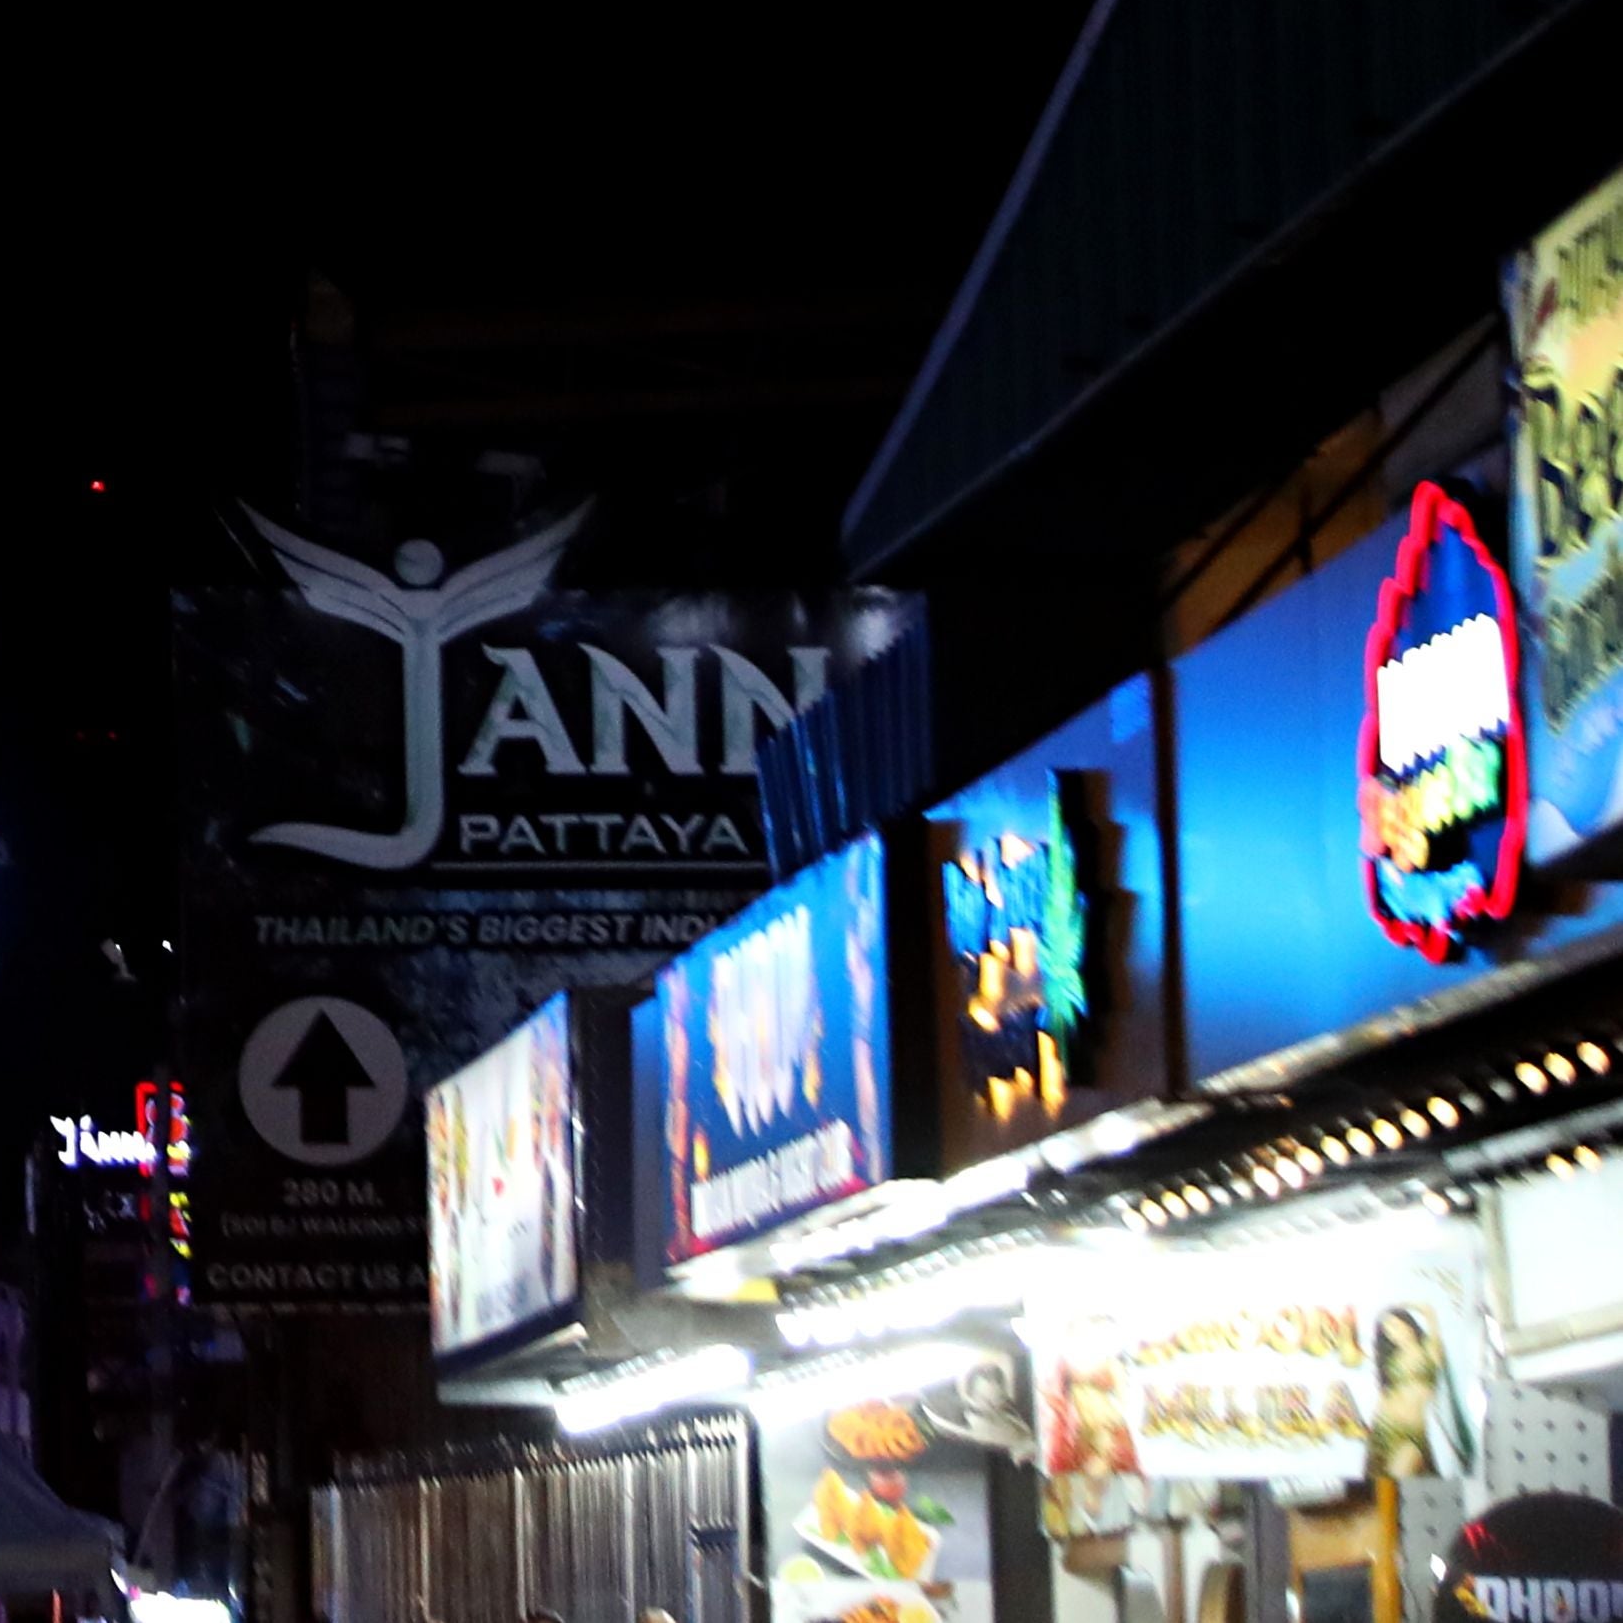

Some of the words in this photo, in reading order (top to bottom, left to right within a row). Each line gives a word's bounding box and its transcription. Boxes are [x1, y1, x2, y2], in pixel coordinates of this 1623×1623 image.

[240, 495, 830, 873] JANN
[456, 810, 752, 857] PATTAYA
[253, 911, 470, 947] THAILAND'S
[476, 911, 635, 947] BIGGEST
[205, 1262, 356, 1291] CONTACT
[360, 1263, 401, 1291] US
[1474, 1574, 1623, 1623] DHOO
